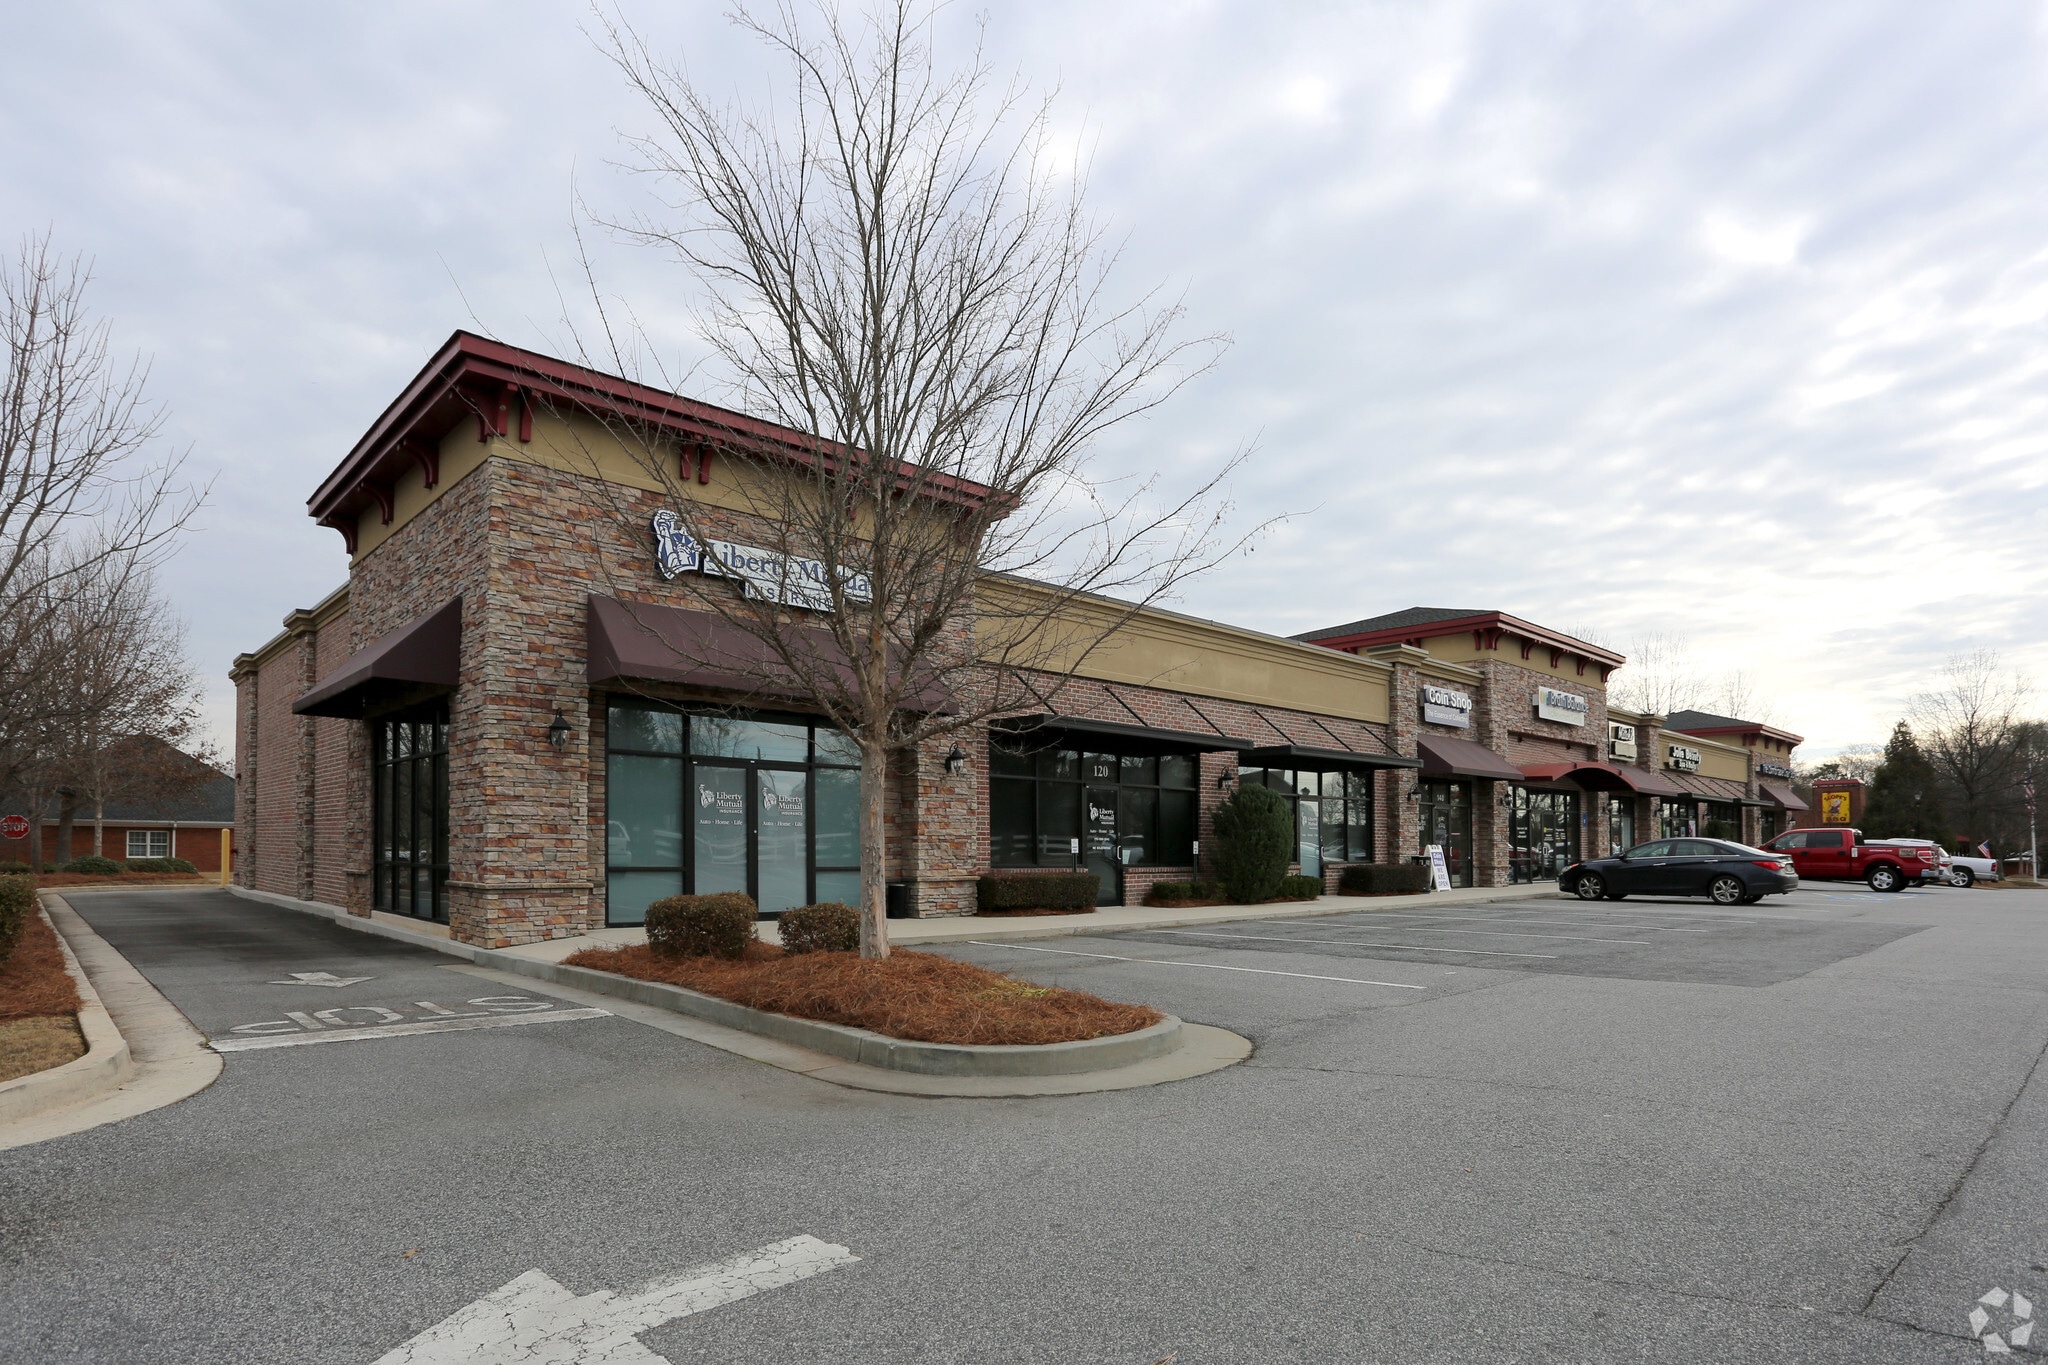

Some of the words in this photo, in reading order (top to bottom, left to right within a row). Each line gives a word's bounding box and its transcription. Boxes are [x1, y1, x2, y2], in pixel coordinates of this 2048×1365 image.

[1428, 687, 1450, 706] Coin
[1450, 692, 1472, 714] Shop
[1094, 765, 1108, 777] 120
[716, 791, 743, 800] Liberty
[778, 795, 802, 804] Liberty
[716, 800, 743, 808] Mutual
[778, 802, 803, 810] Mutual
[1, 822, 28, 832] STOP
[230, 996, 555, 1034] STOP
